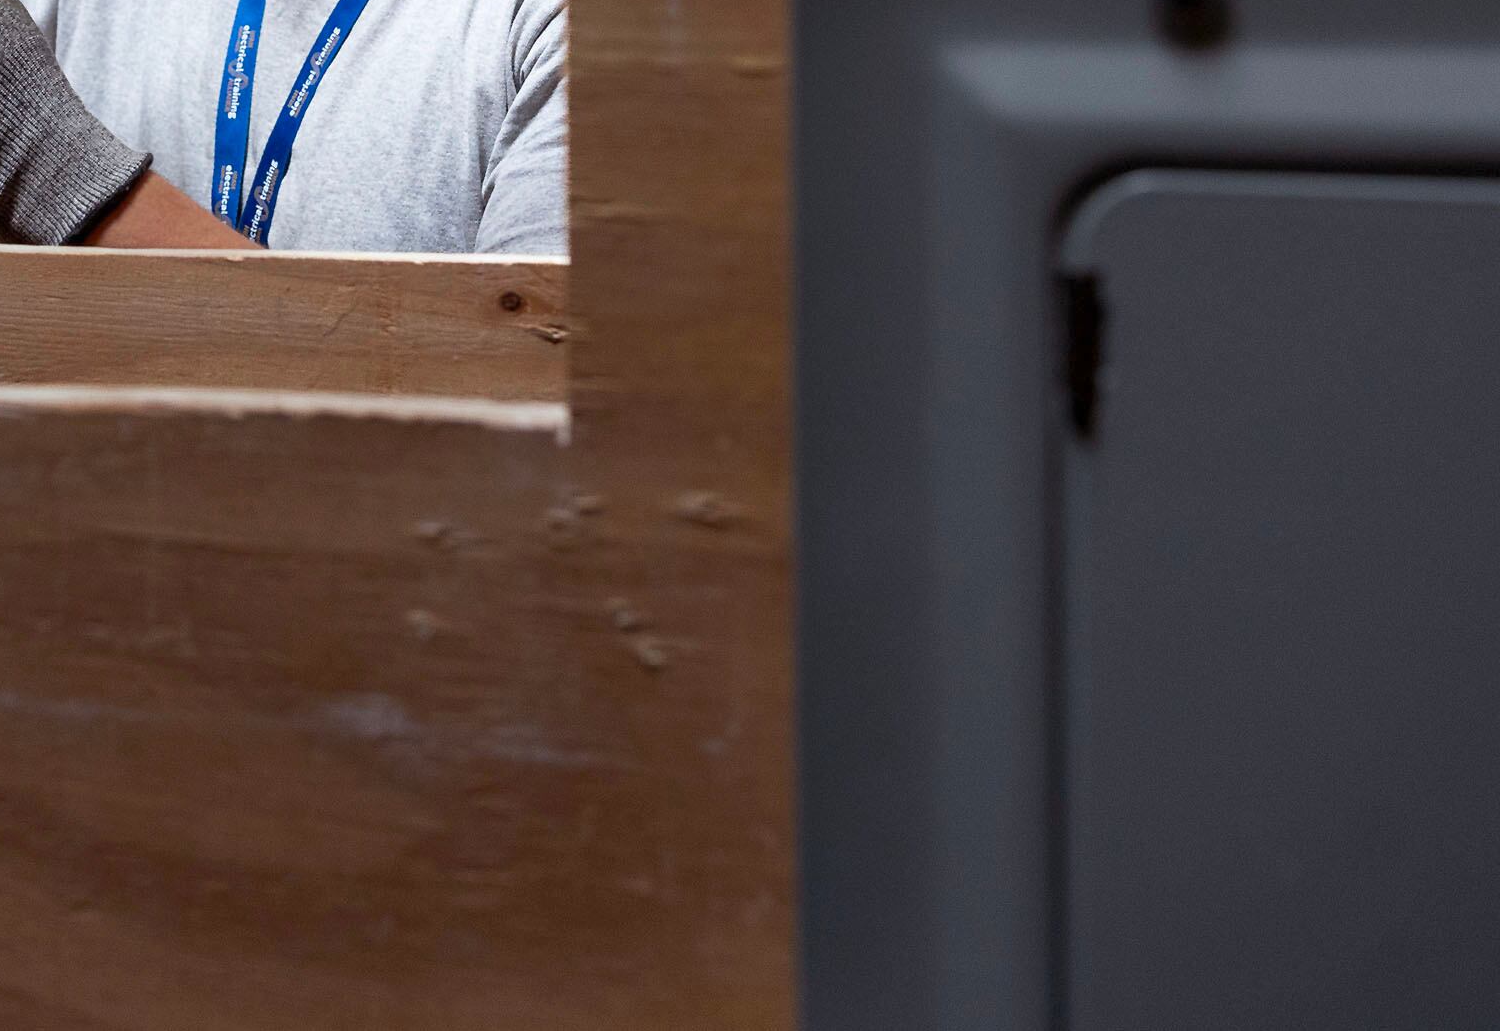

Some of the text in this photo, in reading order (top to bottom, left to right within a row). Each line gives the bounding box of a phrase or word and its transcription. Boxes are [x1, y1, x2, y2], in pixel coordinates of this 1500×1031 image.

[235, 24, 251, 72] electrical
[289, 69, 317, 117] electrical
[315, 26, 341, 66] training
[227, 77, 242, 119] training
[220, 164, 234, 215] electrical
[249, 204, 264, 241] ctrical
[260, 158, 279, 201] training
